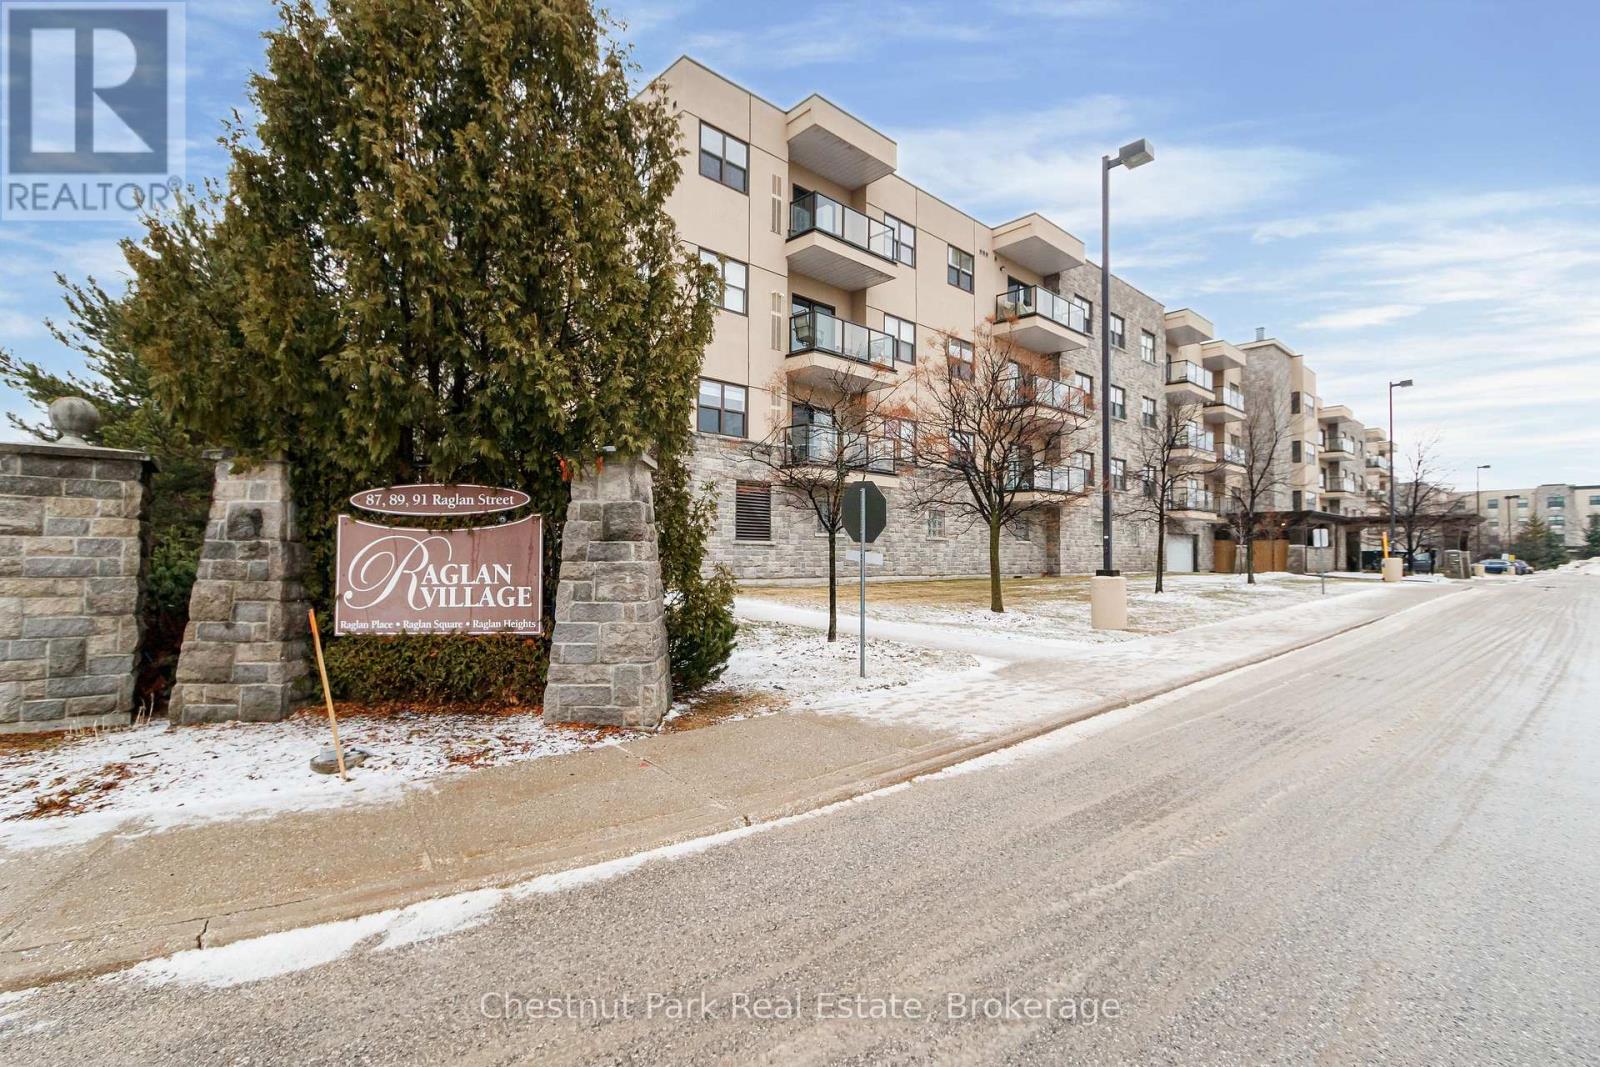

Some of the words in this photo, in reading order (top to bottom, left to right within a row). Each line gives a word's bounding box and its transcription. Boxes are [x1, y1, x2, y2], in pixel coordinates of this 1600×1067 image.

[366, 494, 386, 507] 87,
[389, 494, 409, 507] 89,
[413, 494, 427, 505] 91
[432, 494, 476, 509] Raglan
[478, 493, 514, 505] Street
[344, 535, 513, 611] RAGLAN
[420, 586, 532, 608] VILLAGE
[340, 620, 369, 631] Raglan
[371, 620, 393, 629] Place
[403, 620, 432, 631] Raglan
[433, 619, 463, 631] Square
[473, 619, 501, 630] Raglan
[503, 618, 536, 630] Heights
